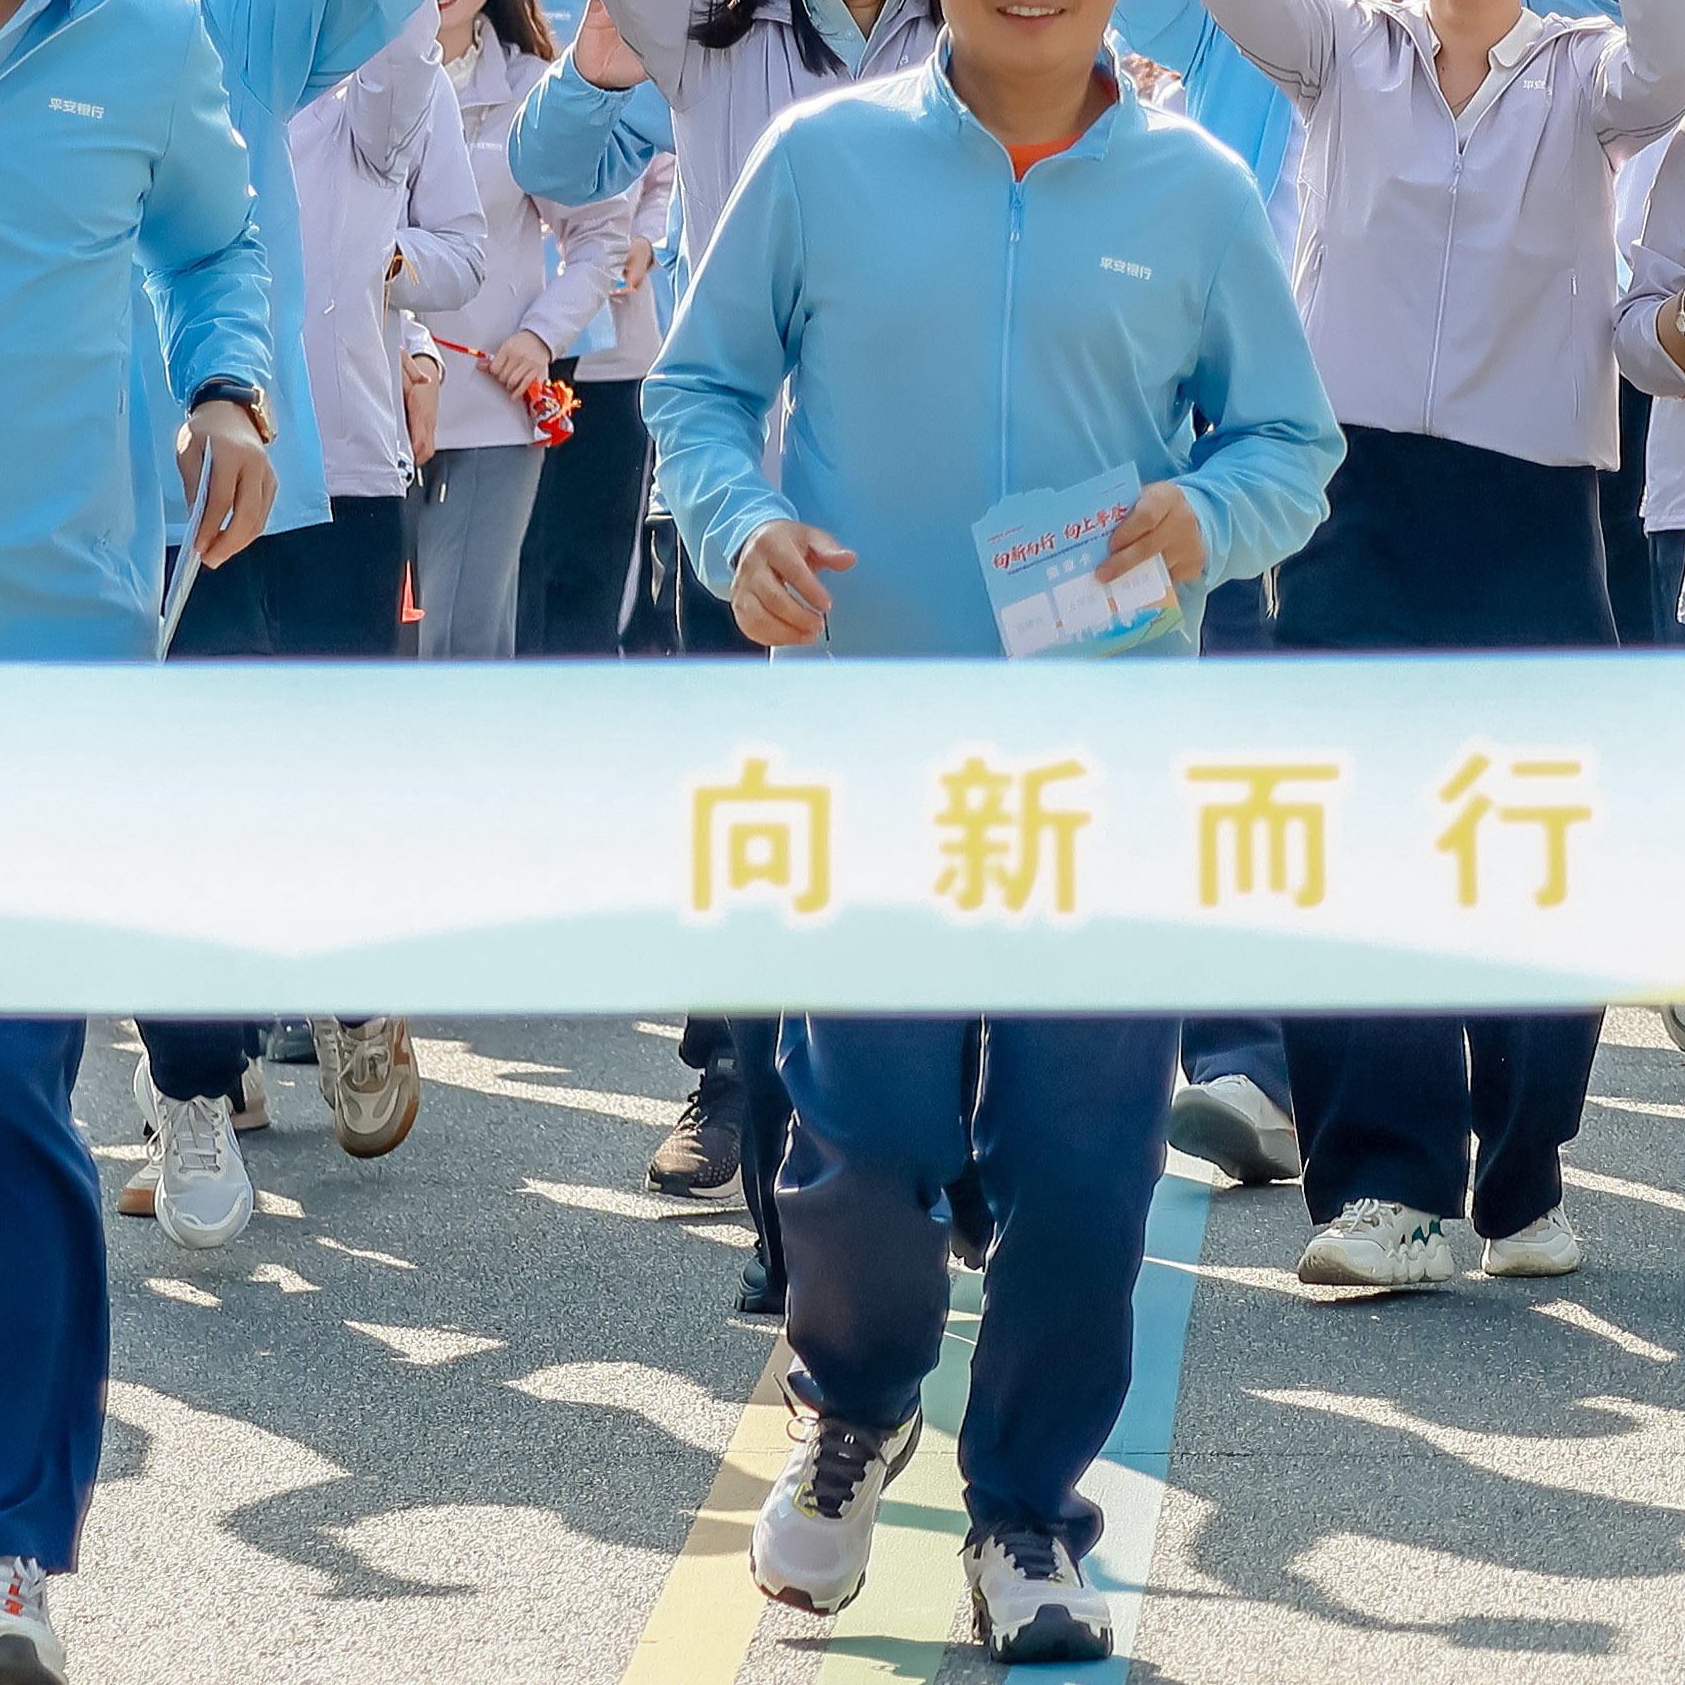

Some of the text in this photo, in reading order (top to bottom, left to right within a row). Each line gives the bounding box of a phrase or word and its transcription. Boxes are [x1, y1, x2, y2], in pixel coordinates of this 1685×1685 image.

[48, 97, 105, 119] 平安银行
[691, 752, 1593, 914] 向新而行
